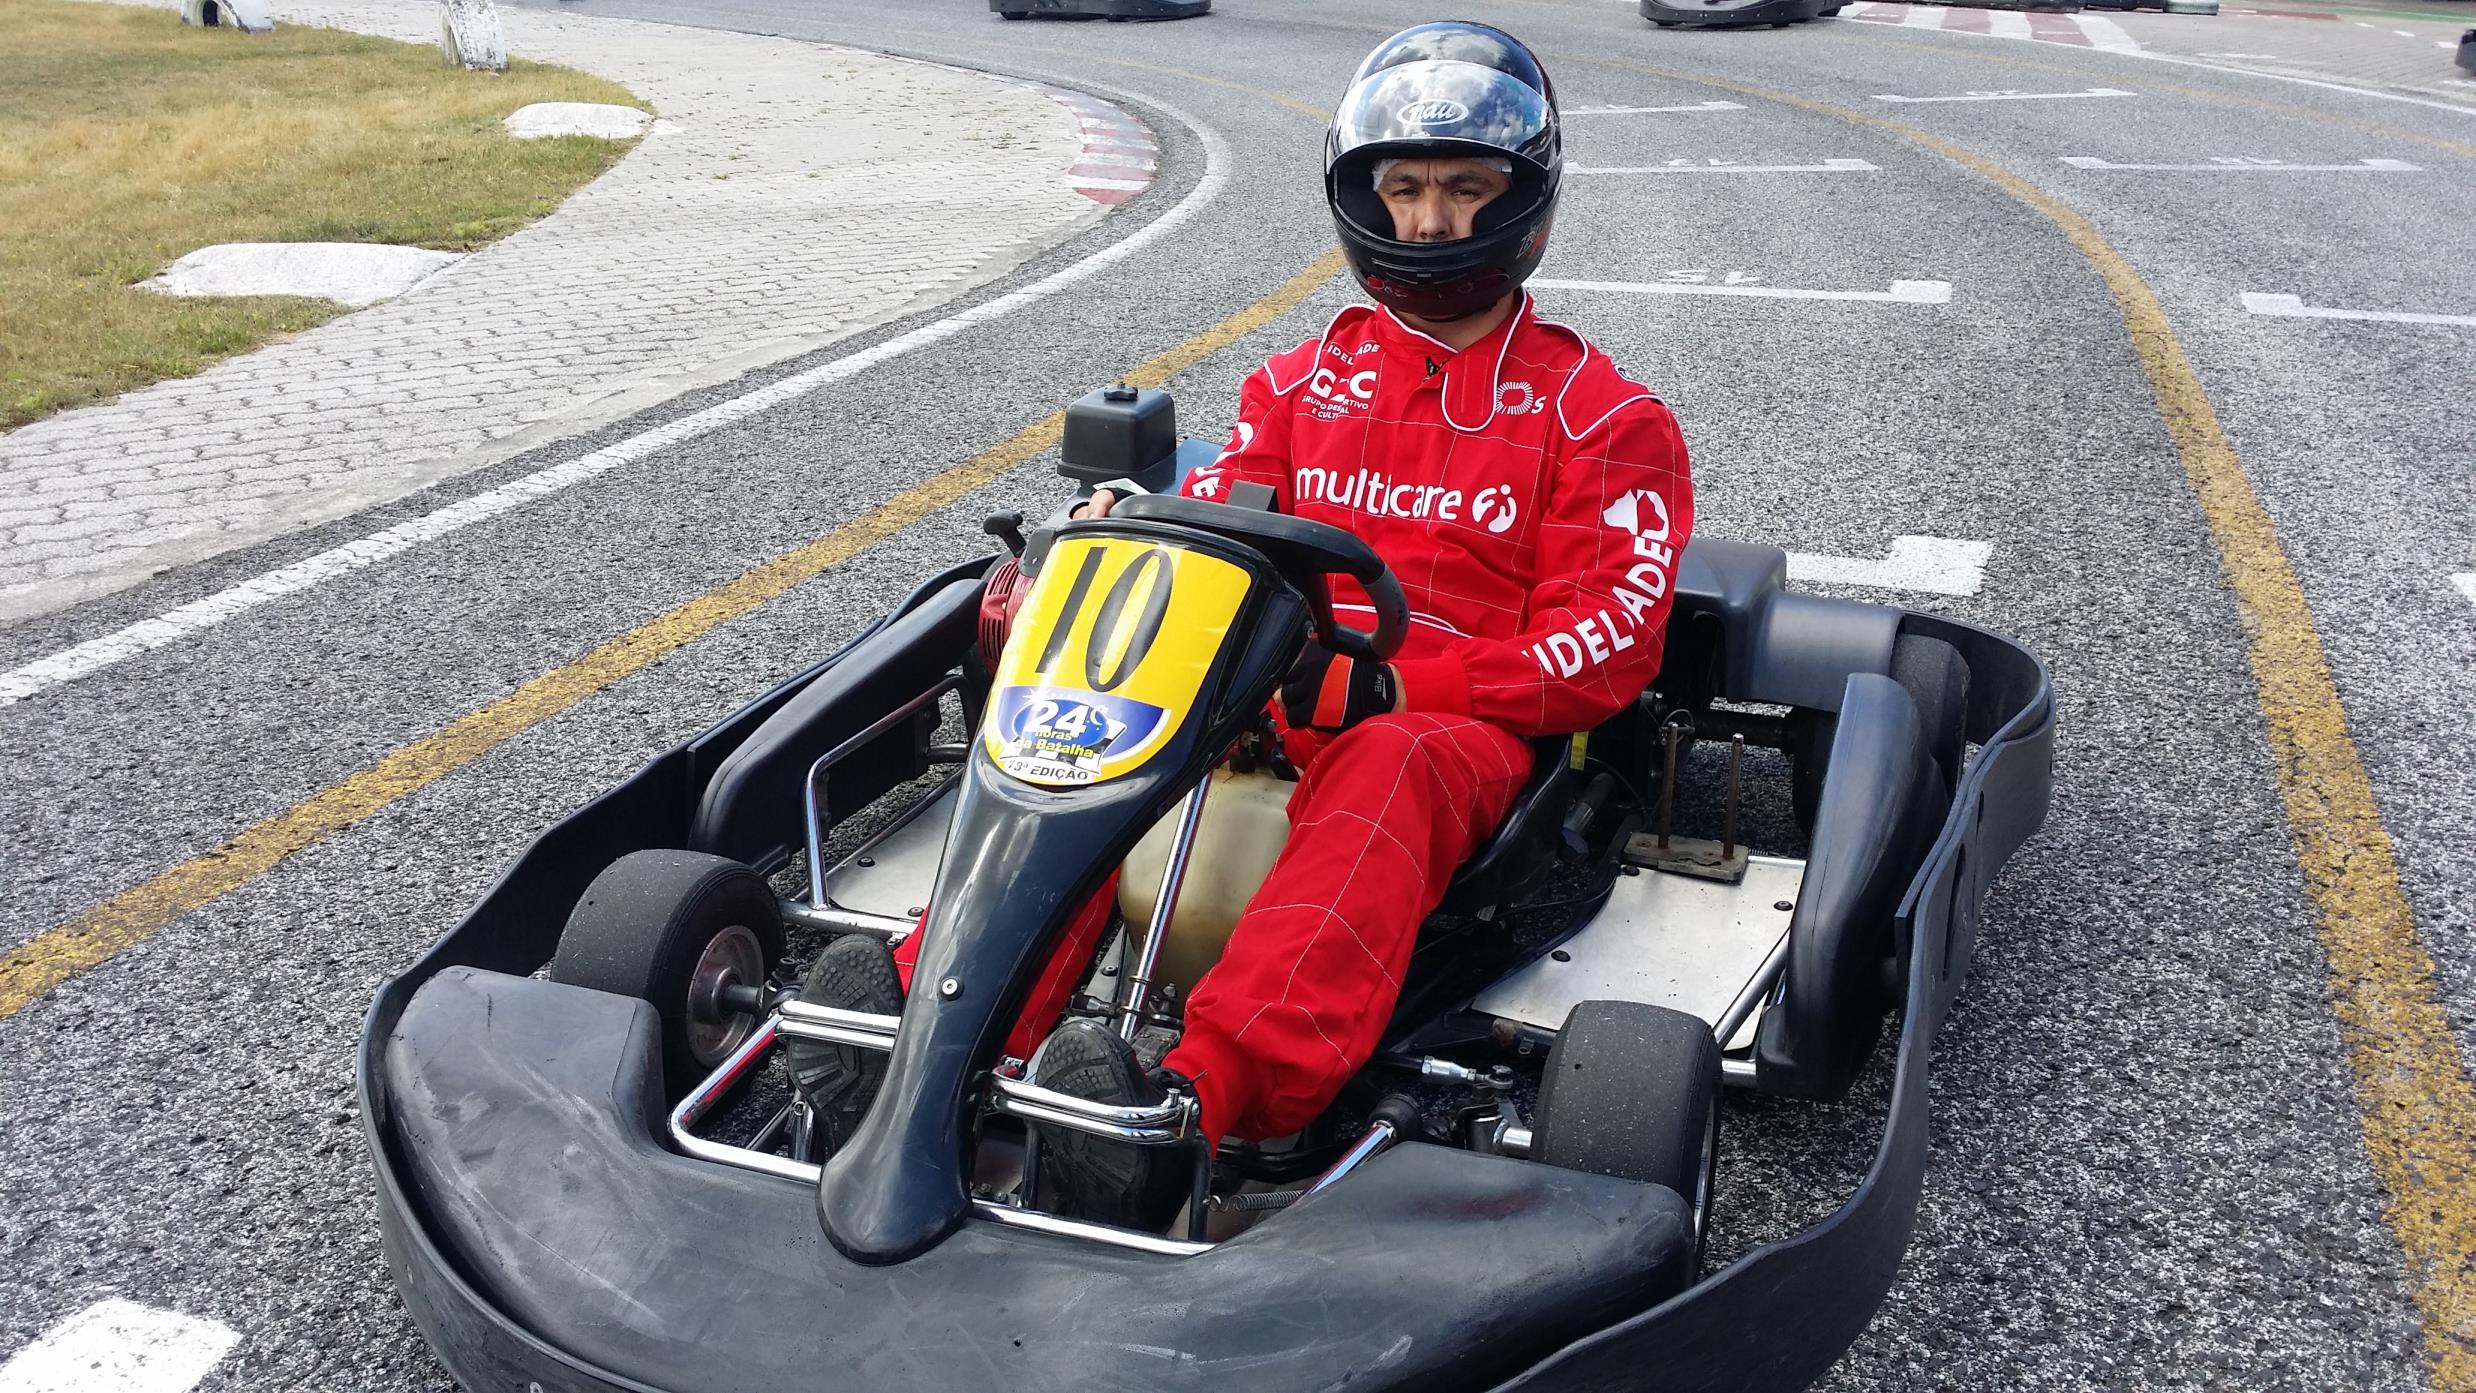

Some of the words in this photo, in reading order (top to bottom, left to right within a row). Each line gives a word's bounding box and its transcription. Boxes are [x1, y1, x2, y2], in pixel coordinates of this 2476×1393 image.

[1296, 467, 1462, 520] multicare
[1035, 547, 1174, 693] 10
[1023, 700, 1090, 738] 24
[1035, 738, 1095, 759] Batalha
[1030, 765, 1089, 781] EDIÇÃO
